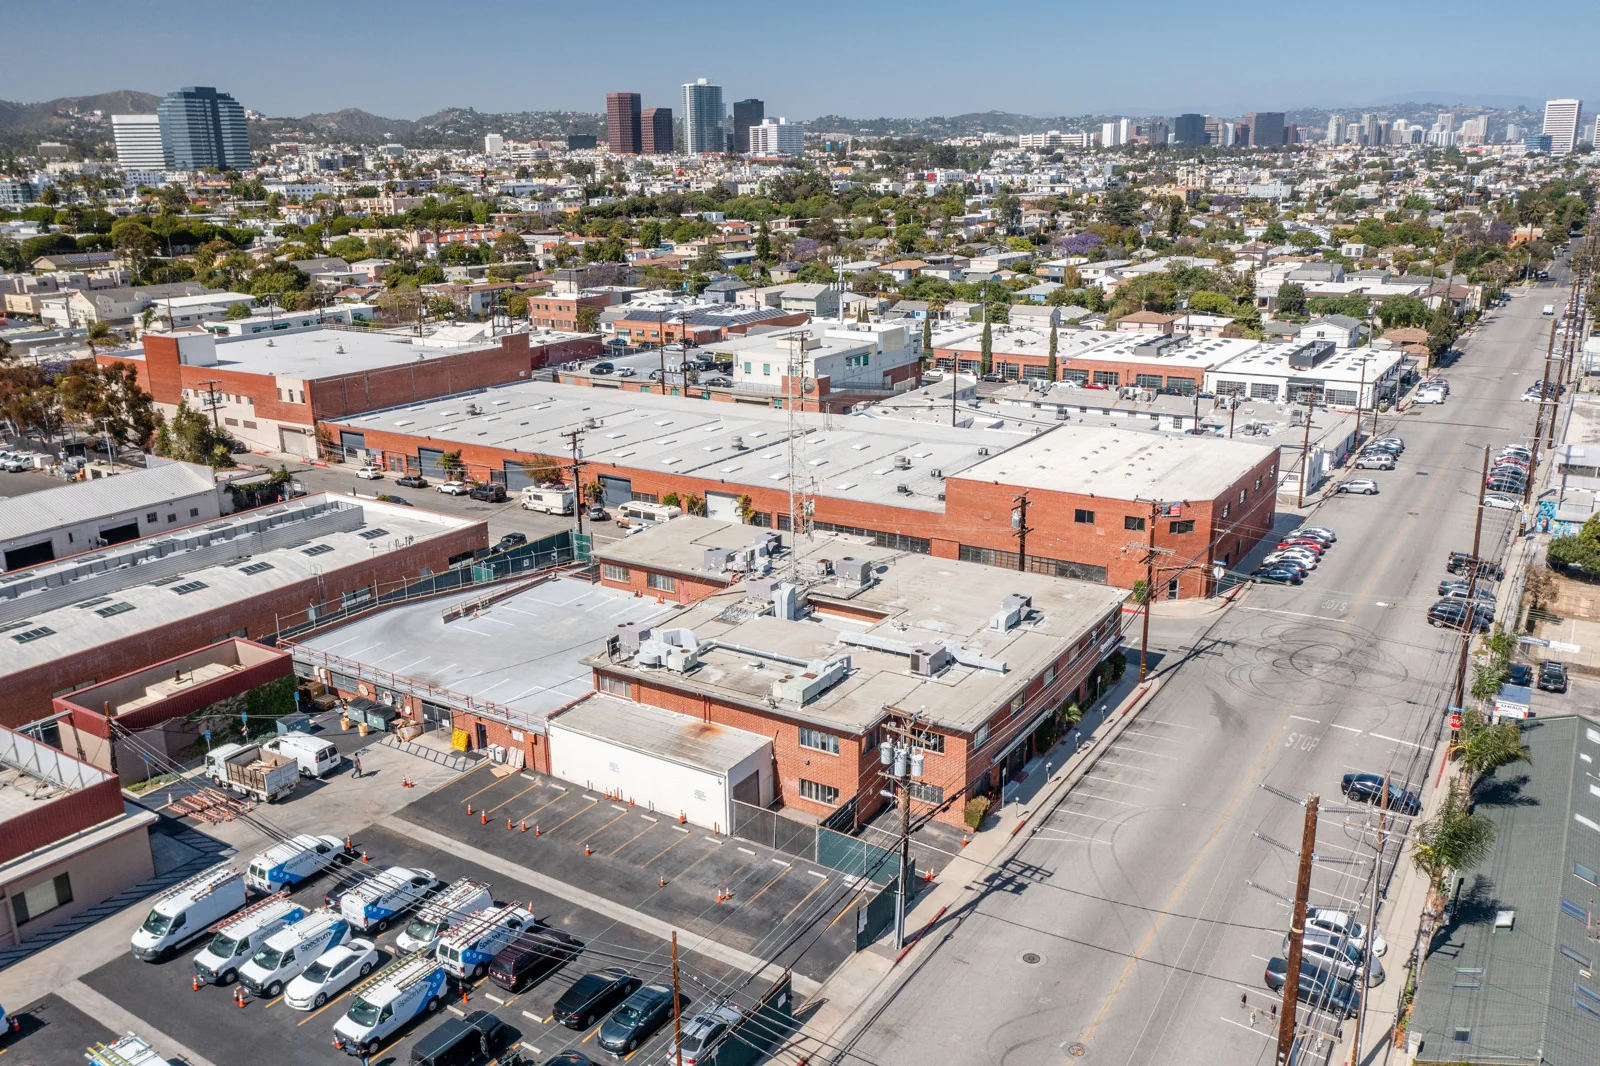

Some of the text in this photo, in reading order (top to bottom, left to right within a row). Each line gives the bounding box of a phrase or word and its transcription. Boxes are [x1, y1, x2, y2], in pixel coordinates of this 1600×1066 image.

[1285, 732, 1320, 752] STOP
[255, 922, 286, 942] Spectrum
[301, 931, 332, 951] Spectrum
[397, 985, 427, 1007] Spectrum
